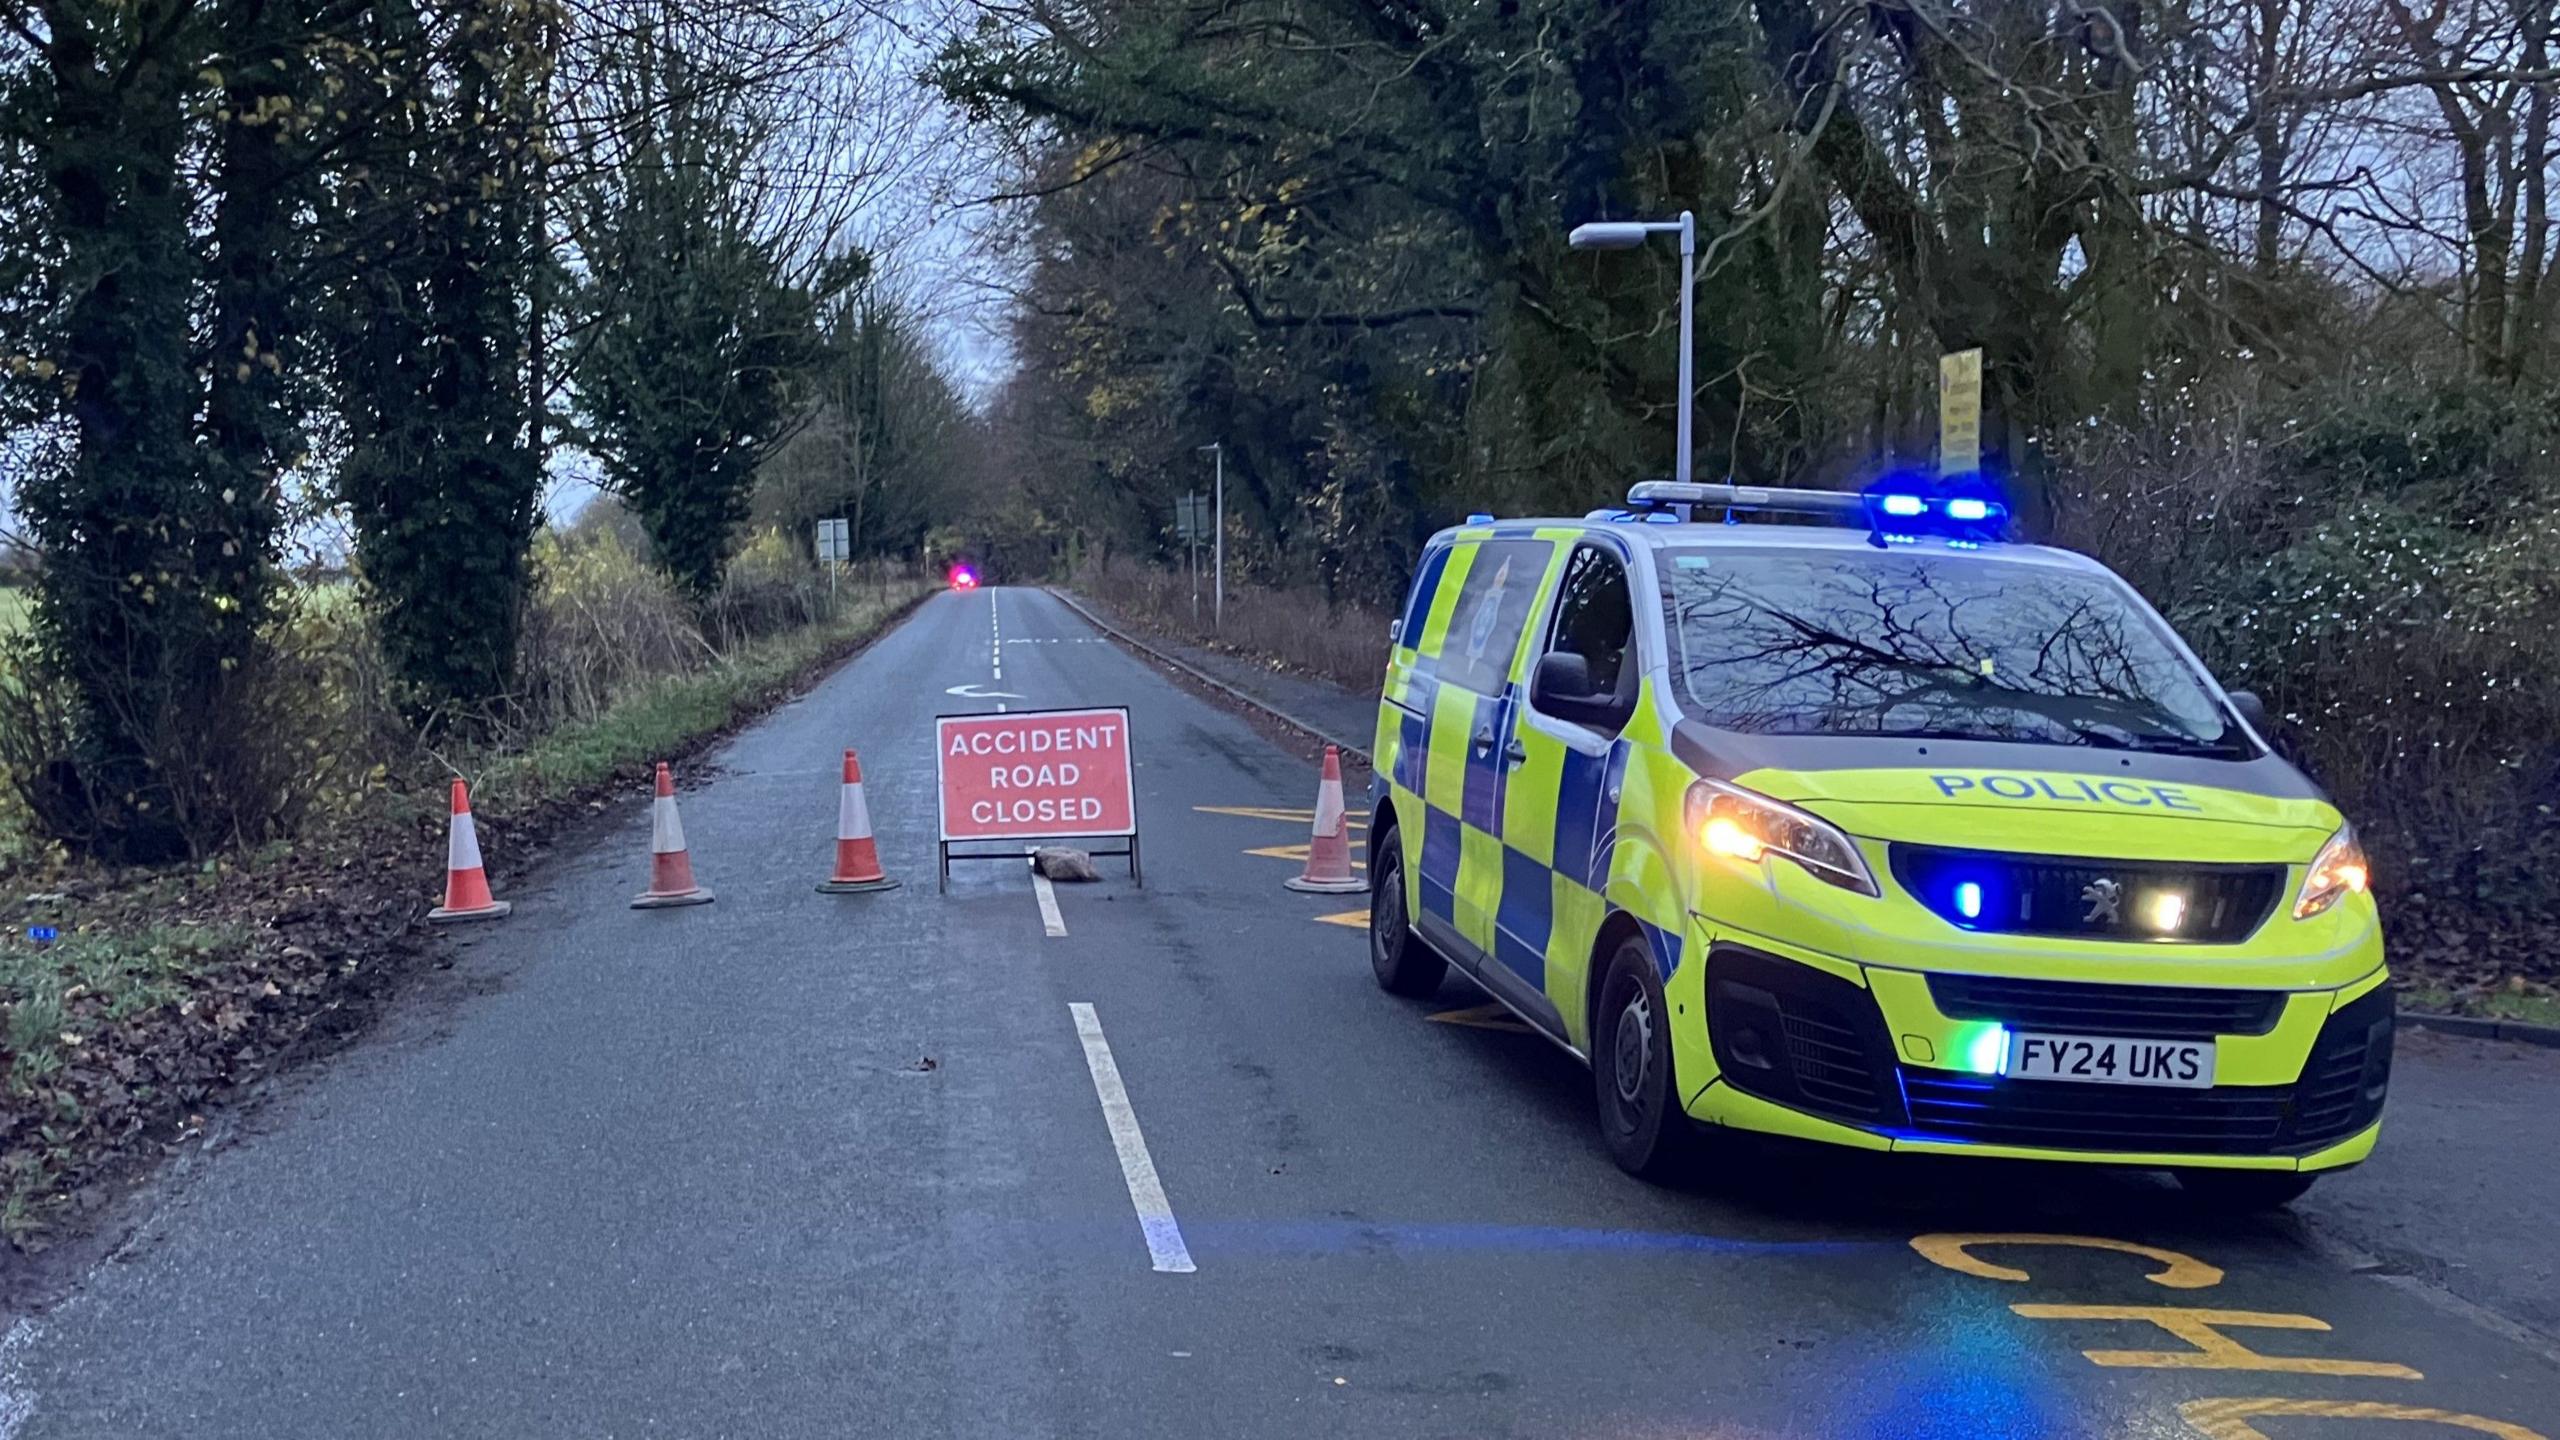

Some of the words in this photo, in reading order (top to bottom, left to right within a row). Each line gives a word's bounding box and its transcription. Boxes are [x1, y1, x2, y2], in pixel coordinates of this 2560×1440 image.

[950, 726, 1117, 757] ACCIDENT
[991, 764, 1080, 789] ROAD
[1930, 775, 2203, 812] POLICE
[971, 798, 1102, 824] CLOSED
[2021, 1039, 2117, 1077] FY24
[2129, 1045, 2200, 1080] UKS
